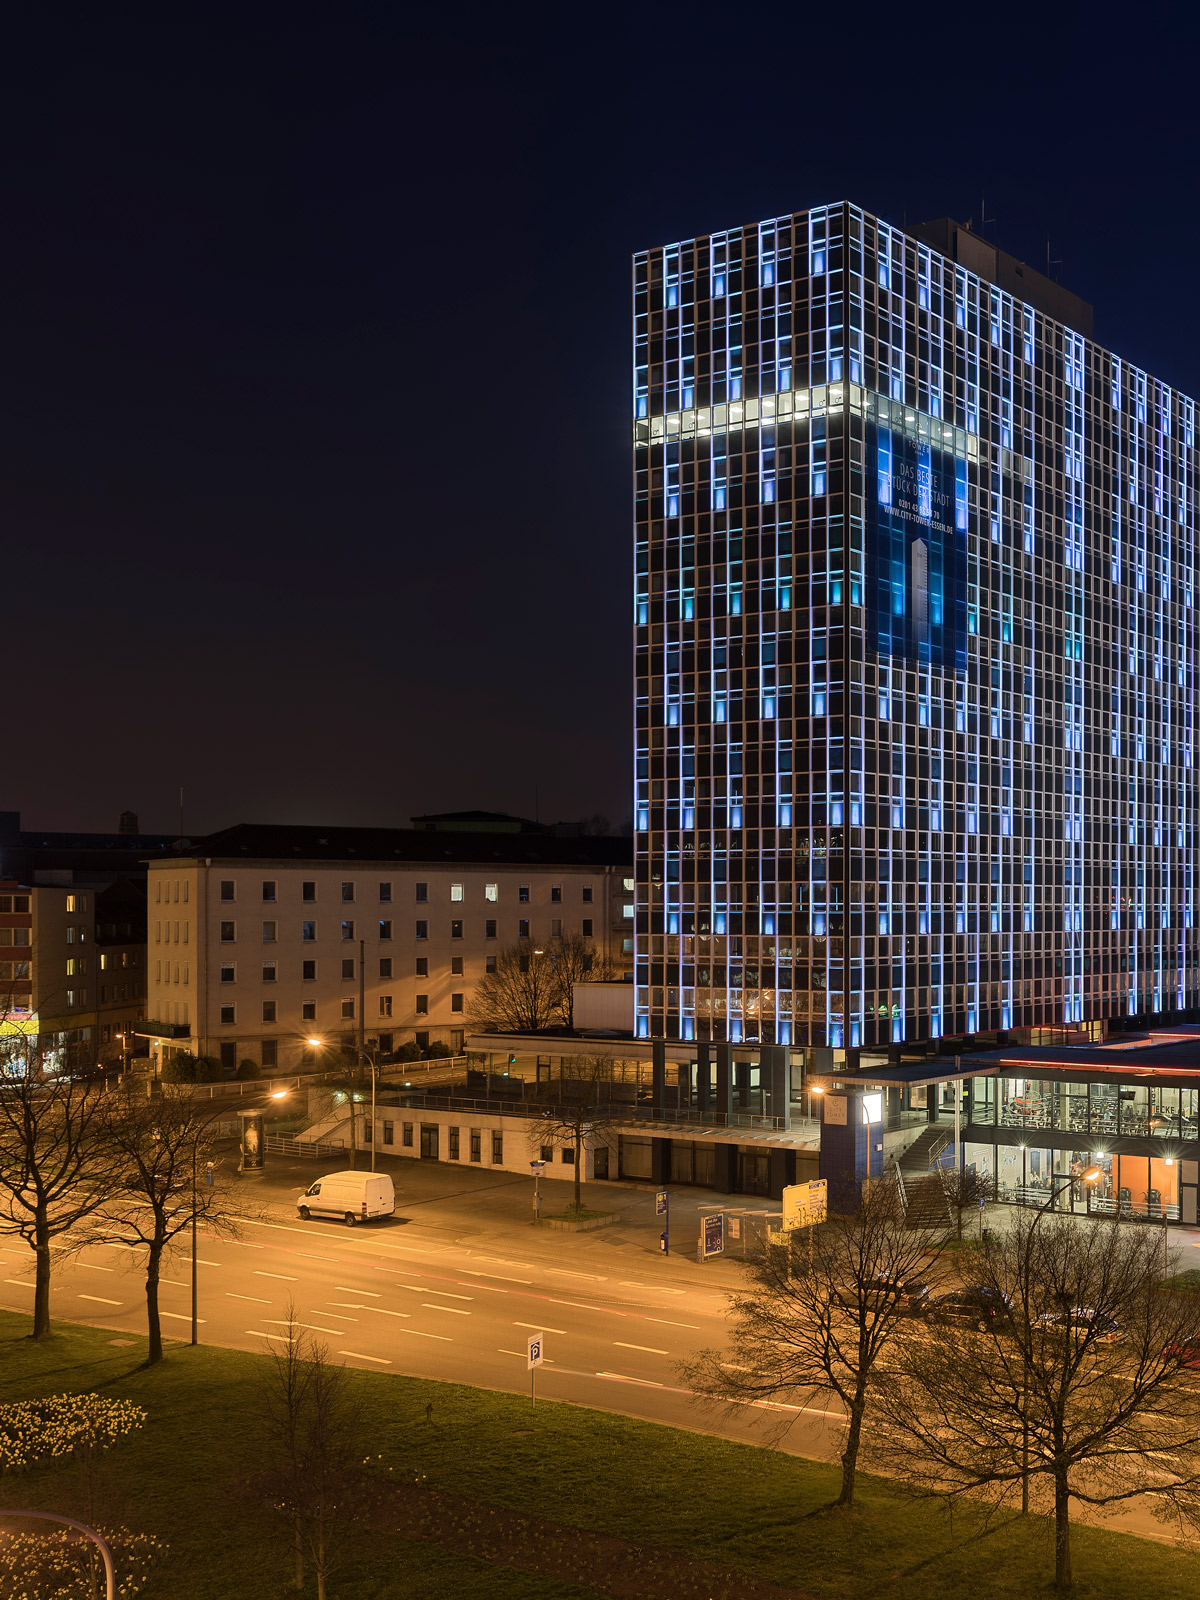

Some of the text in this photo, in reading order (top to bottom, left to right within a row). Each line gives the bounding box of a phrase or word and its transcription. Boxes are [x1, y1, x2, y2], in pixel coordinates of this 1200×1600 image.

[888, 474, 950, 507] STÜCK DER STADT
[900, 463, 938, 488] DAS BESTE
[884, 504, 954, 534] WWW.CITY-TOWER-ESSEN.DE
